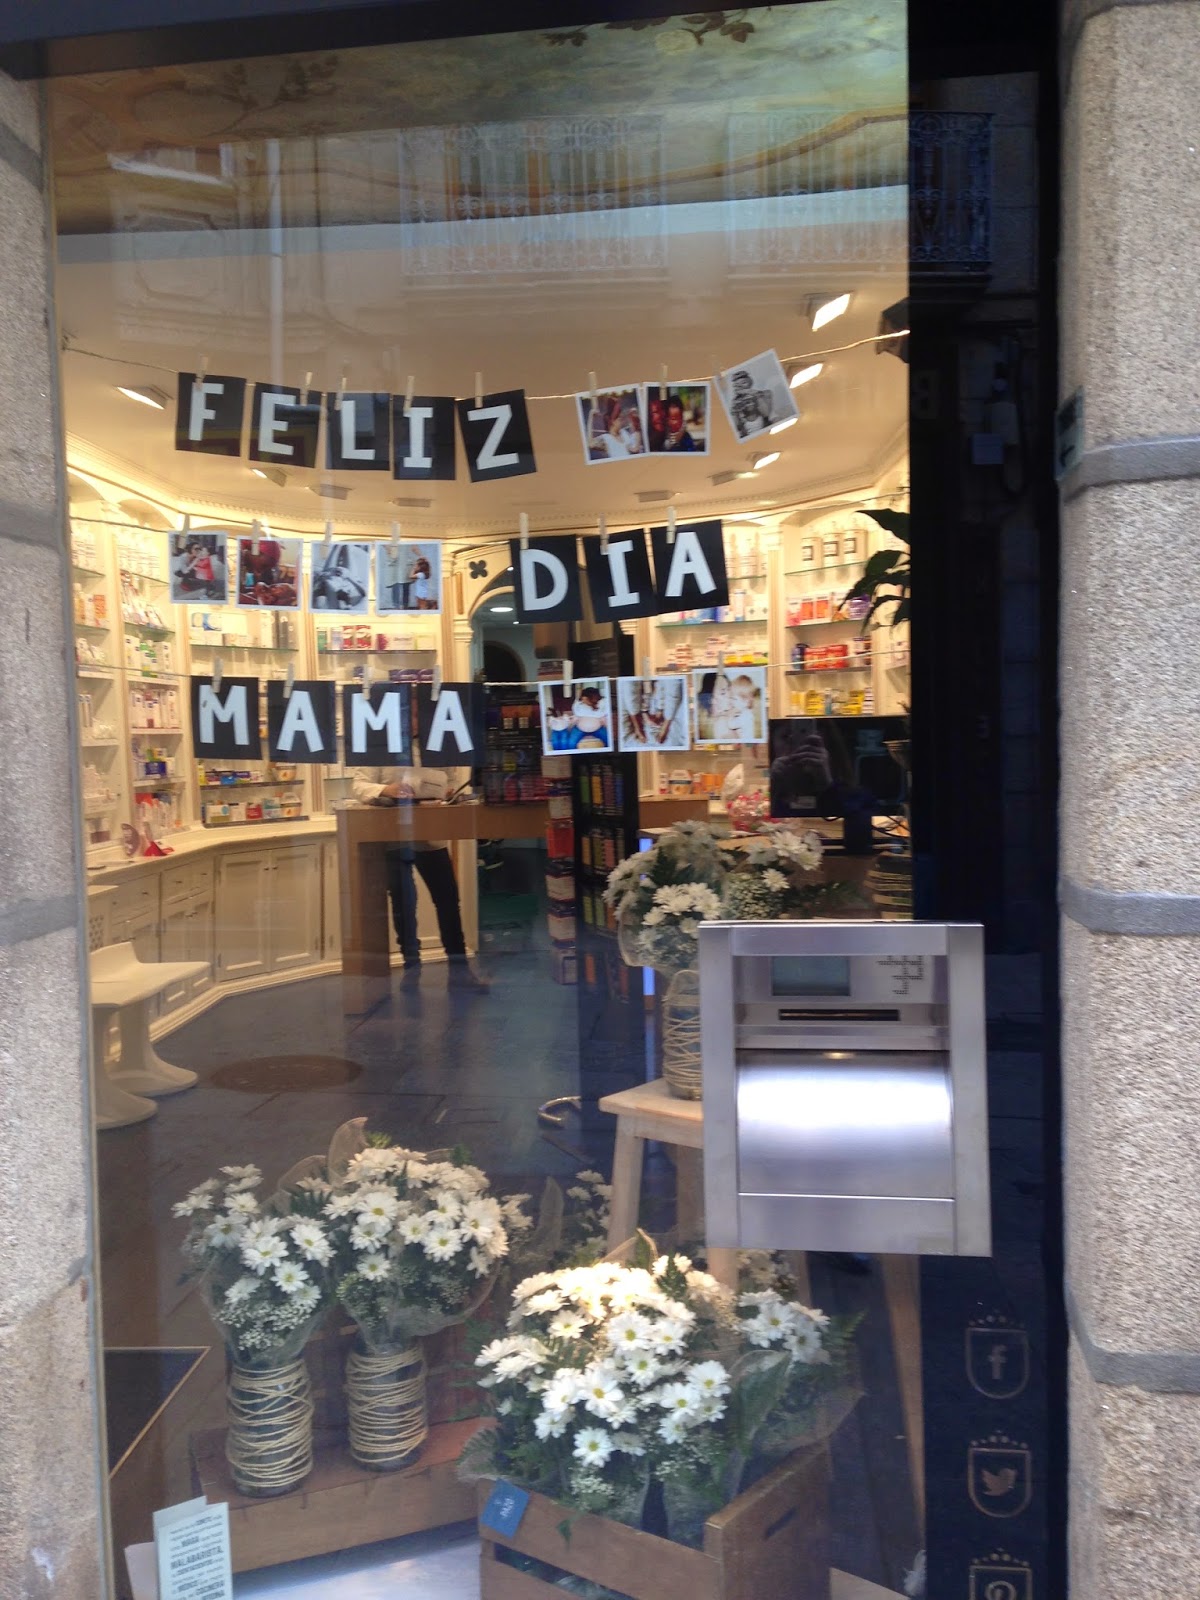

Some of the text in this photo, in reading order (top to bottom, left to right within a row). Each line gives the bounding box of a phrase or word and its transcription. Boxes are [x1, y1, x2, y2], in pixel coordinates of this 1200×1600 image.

[188, 382, 520, 469] FELIZ
[520, 531, 718, 611] DIA
[198, 684, 474, 754] MAMA
